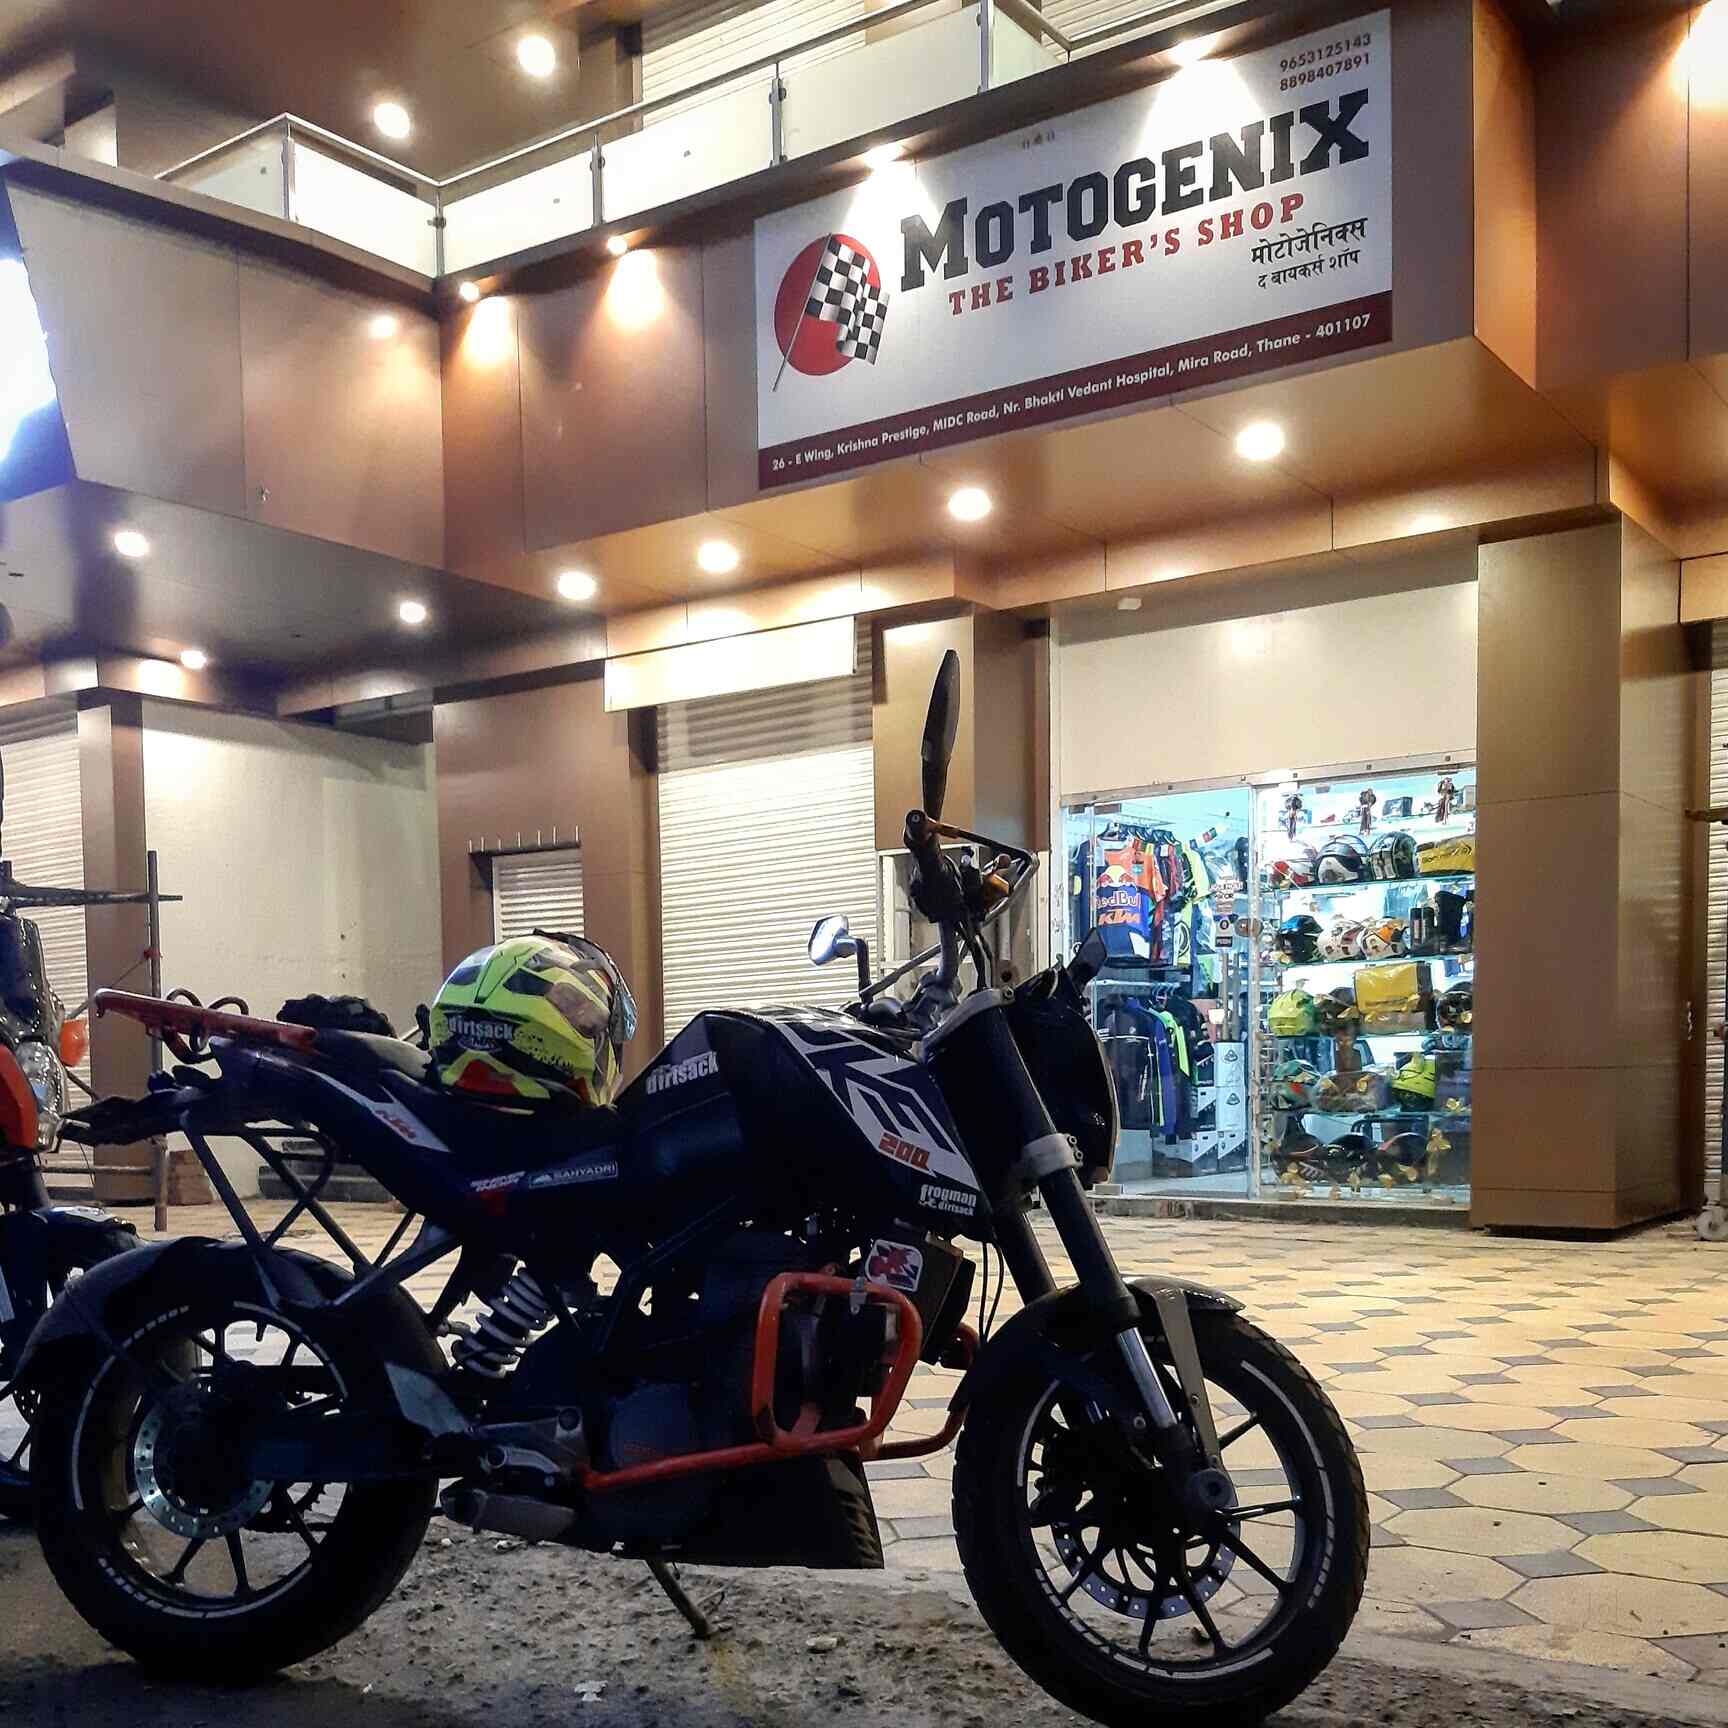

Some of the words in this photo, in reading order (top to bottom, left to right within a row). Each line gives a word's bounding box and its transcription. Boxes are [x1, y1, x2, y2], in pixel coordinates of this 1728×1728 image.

[1280, 32, 1371, 73] 9653125143
[1280, 53, 1370, 92] 8898407891
[901, 88, 1369, 292] MOTOGENIX
[948, 274, 1014, 316] THE
[1029, 226, 1180, 295] BIKER'S
[1197, 192, 1305, 248] SHOP
[1250, 217, 1369, 265] मोटोजेनिक्स
[1258, 274, 1268, 289] द
[1271, 253, 1325, 285] बायकर्स
[1329, 248, 1361, 270] शॉप
[772, 458, 785, 471] 26
[796, 455, 802, 465] E
[804, 448, 834, 464] Wing,
[837, 436, 879, 455] Krishna
[881, 423, 930, 445] Prestige,
[933, 414, 963, 432] MIDC
[966, 404, 1000, 424] Road,
[1003, 402, 1021, 415] Nr.
[1024, 388, 1064, 410] Bhakti
[1067, 377, 1113, 398] Vedant
[1116, 362, 1175, 388] Hospital,
[1178, 355, 1210, 372] Mira
[1213, 343, 1252, 364] Road,
[1256, 333, 1301, 353] Thane
[1315, 313, 1371, 338] 401107
[448, 1015, 513, 1039] dirtsack
[646, 1051, 719, 1095] dirtsack
[879, 1132, 930, 1171] 200
[920, 1184, 977, 1207] frogman
[938, 1200, 974, 1216] dirtsack
